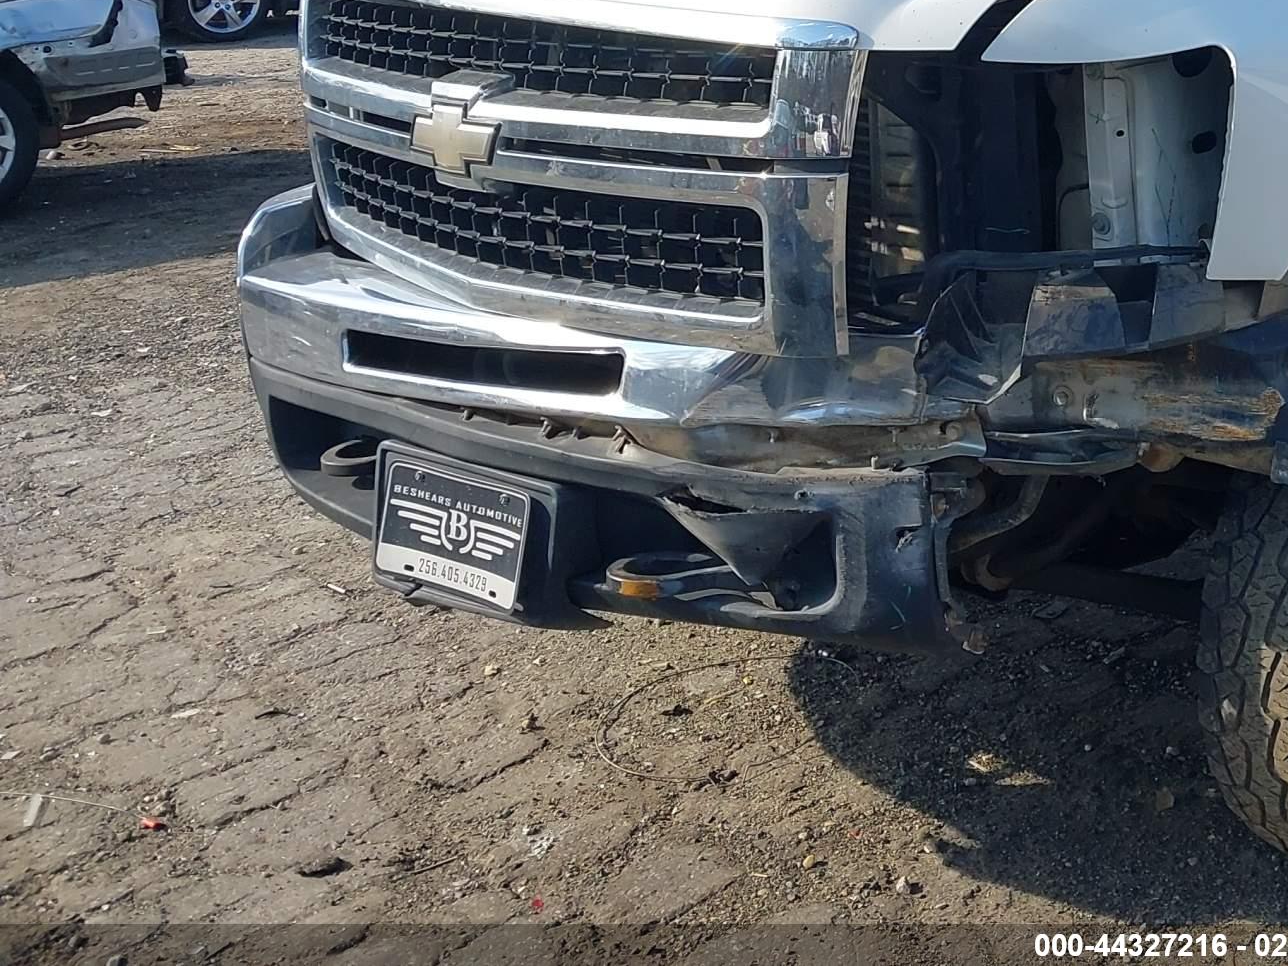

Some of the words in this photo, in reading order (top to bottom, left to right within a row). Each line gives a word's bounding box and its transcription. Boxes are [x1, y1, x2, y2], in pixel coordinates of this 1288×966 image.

[393, 484, 452, 507] BESHEARS
[455, 500, 524, 528] AUTOMOTIVE
[447, 508, 469, 541] B
[418, 557, 488, 593] 256.405.4329
